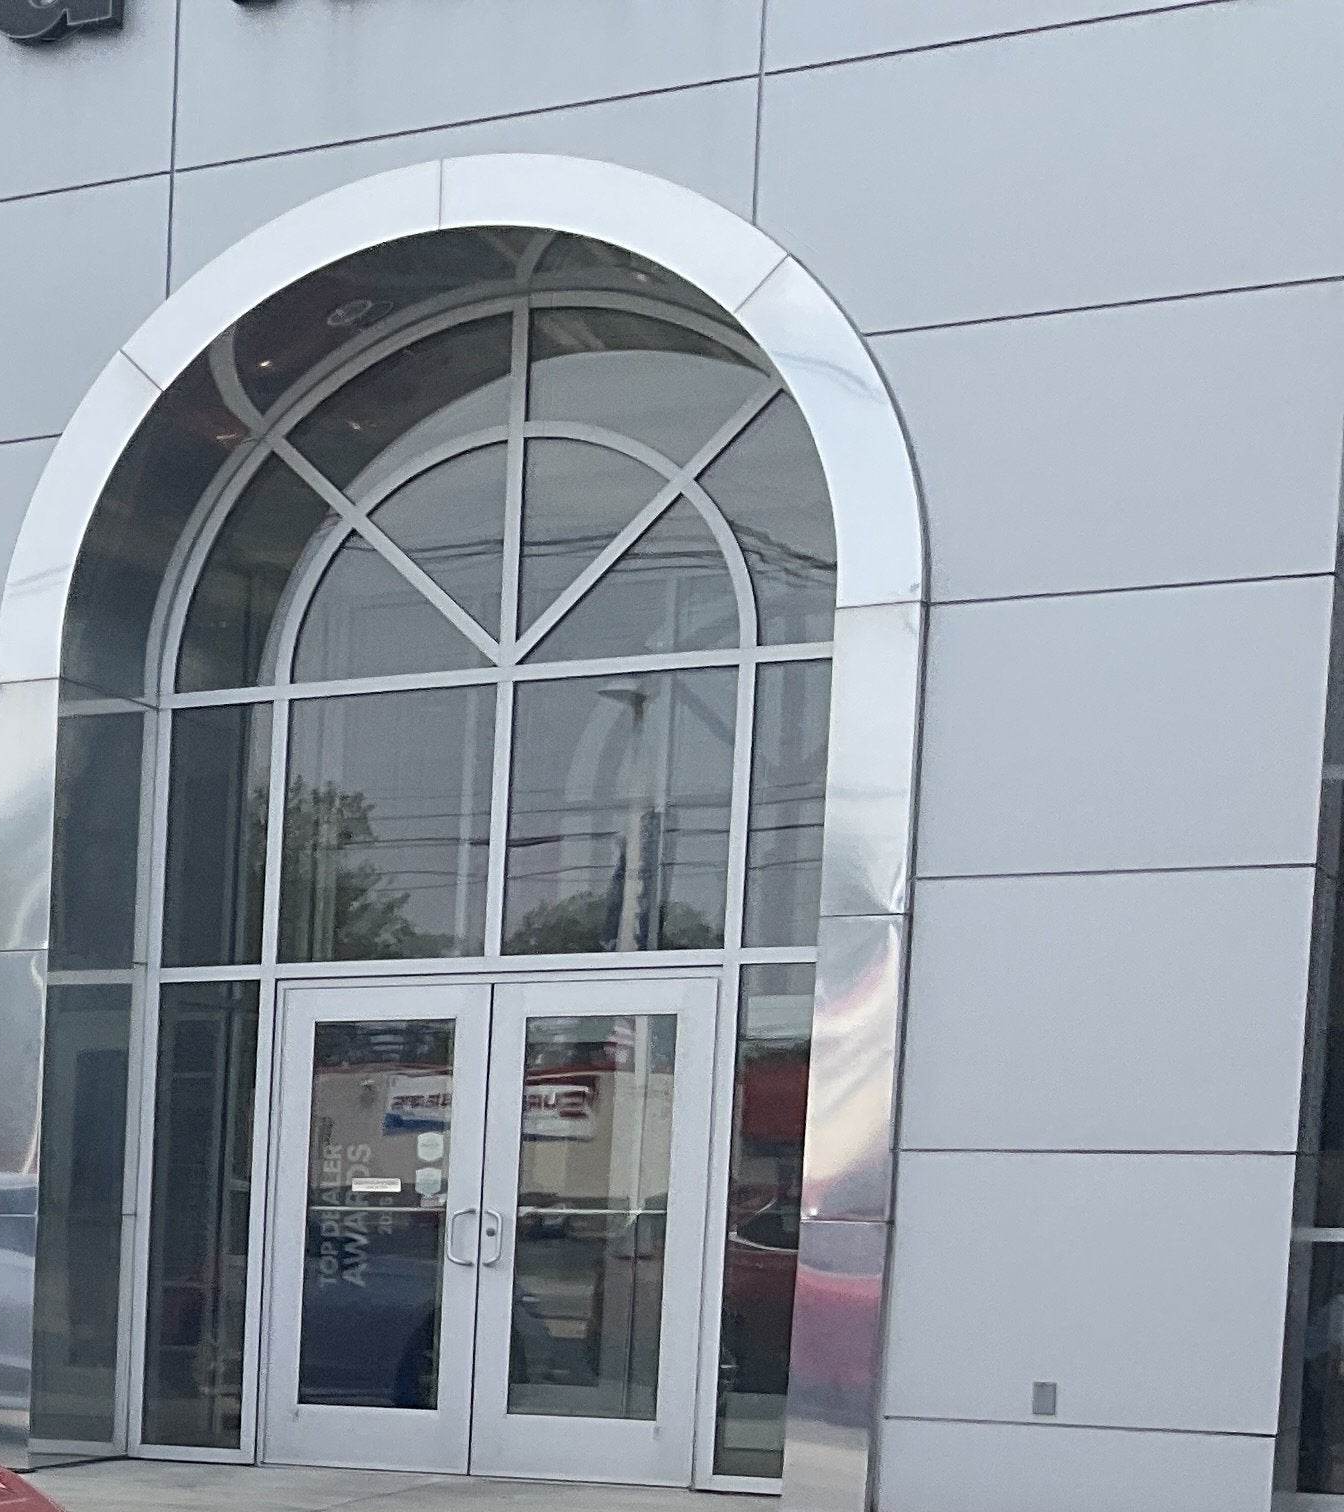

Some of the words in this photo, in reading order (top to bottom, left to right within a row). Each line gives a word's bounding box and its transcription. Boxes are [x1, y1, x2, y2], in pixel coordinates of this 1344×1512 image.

[320, 1144, 343, 1238] DEALER
[342, 1143, 372, 1288] AWARDS
[319, 1240, 340, 1288] TOP
